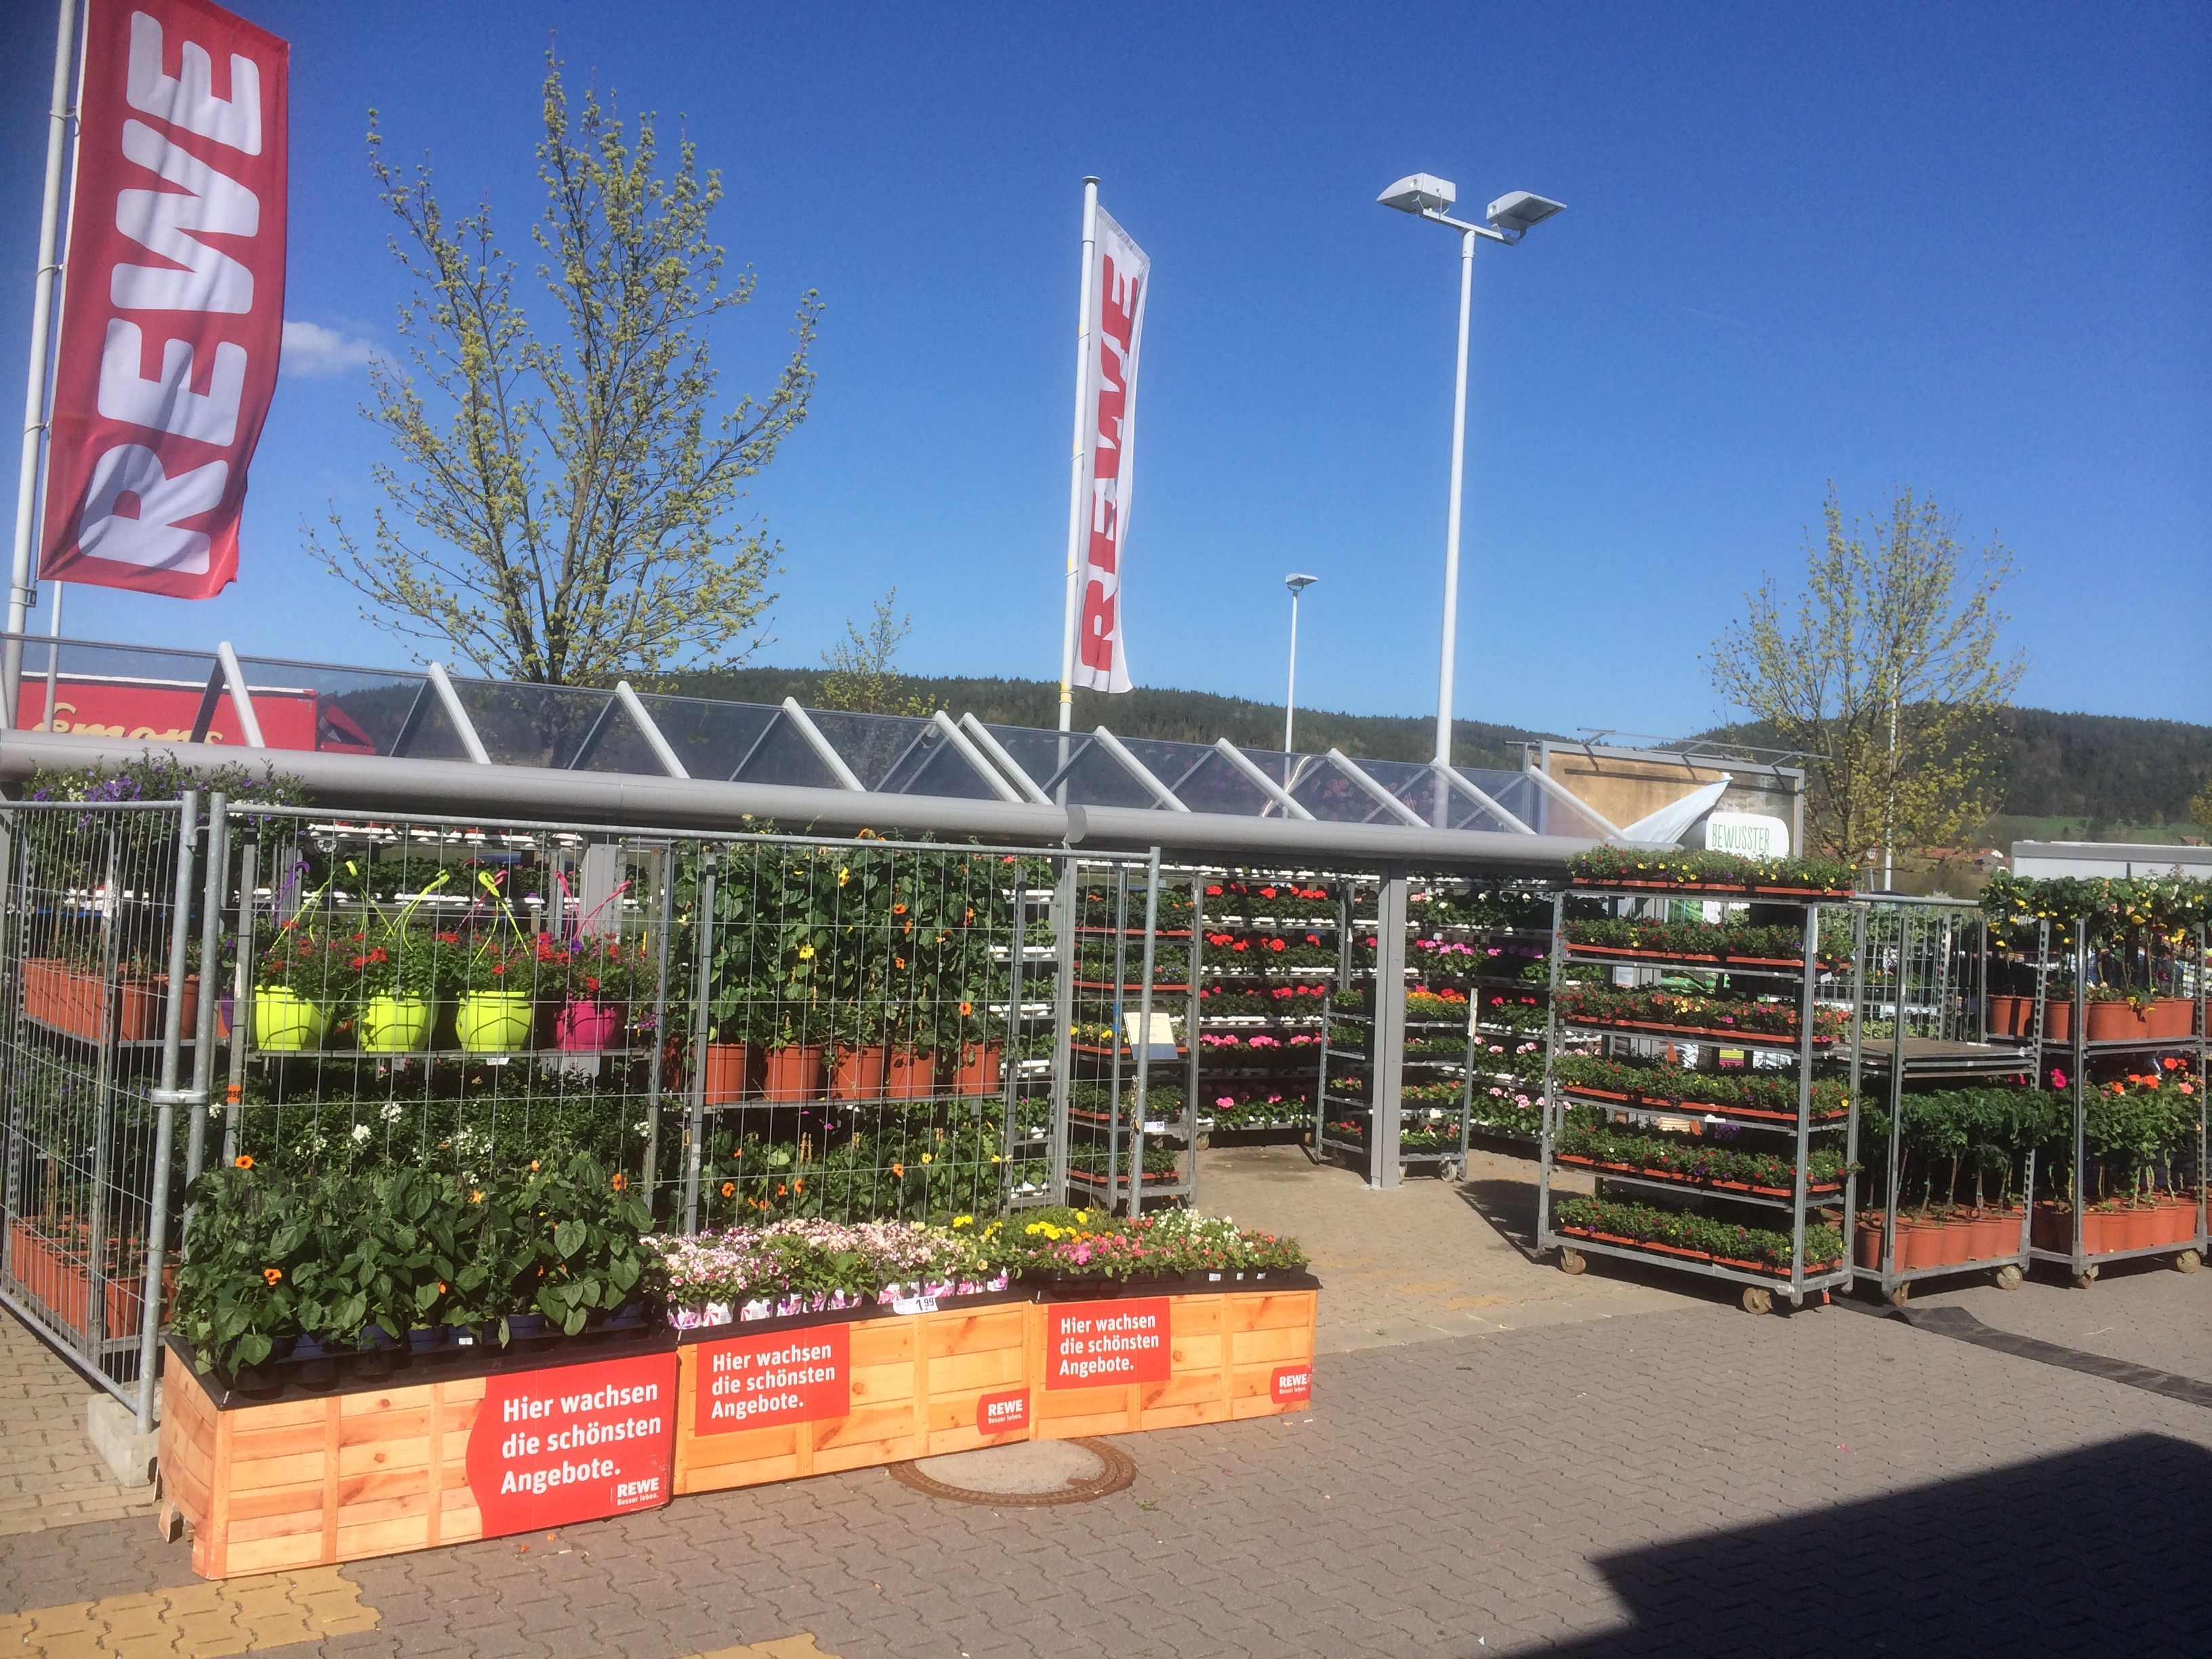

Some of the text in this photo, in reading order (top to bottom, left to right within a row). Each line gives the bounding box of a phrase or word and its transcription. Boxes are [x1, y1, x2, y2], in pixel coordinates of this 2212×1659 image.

[79, 10, 262, 575] REWE
[1080, 253, 1139, 672] REWE
[1712, 823, 1770, 852] BEWUSSTER
[1061, 1313, 1156, 1335] Hier wachsen
[713, 1344, 832, 1373] Hier wachsen
[1060, 1334, 1160, 1355] die schönsten
[1059, 1355, 1134, 1378] Angebote.
[1279, 1373, 1307, 1388] REWE
[712, 1366, 836, 1396] die schönsten
[504, 1384, 658, 1423] Hier wachsen
[711, 1392, 804, 1420] Angebote.
[987, 1399, 1023, 1416] REWE
[501, 1416, 661, 1459] die schönsten
[500, 1458, 621, 1495] Angebote.
[617, 1477, 659, 1498] REWE
[617, 1493, 659, 1506] Besser leben.
